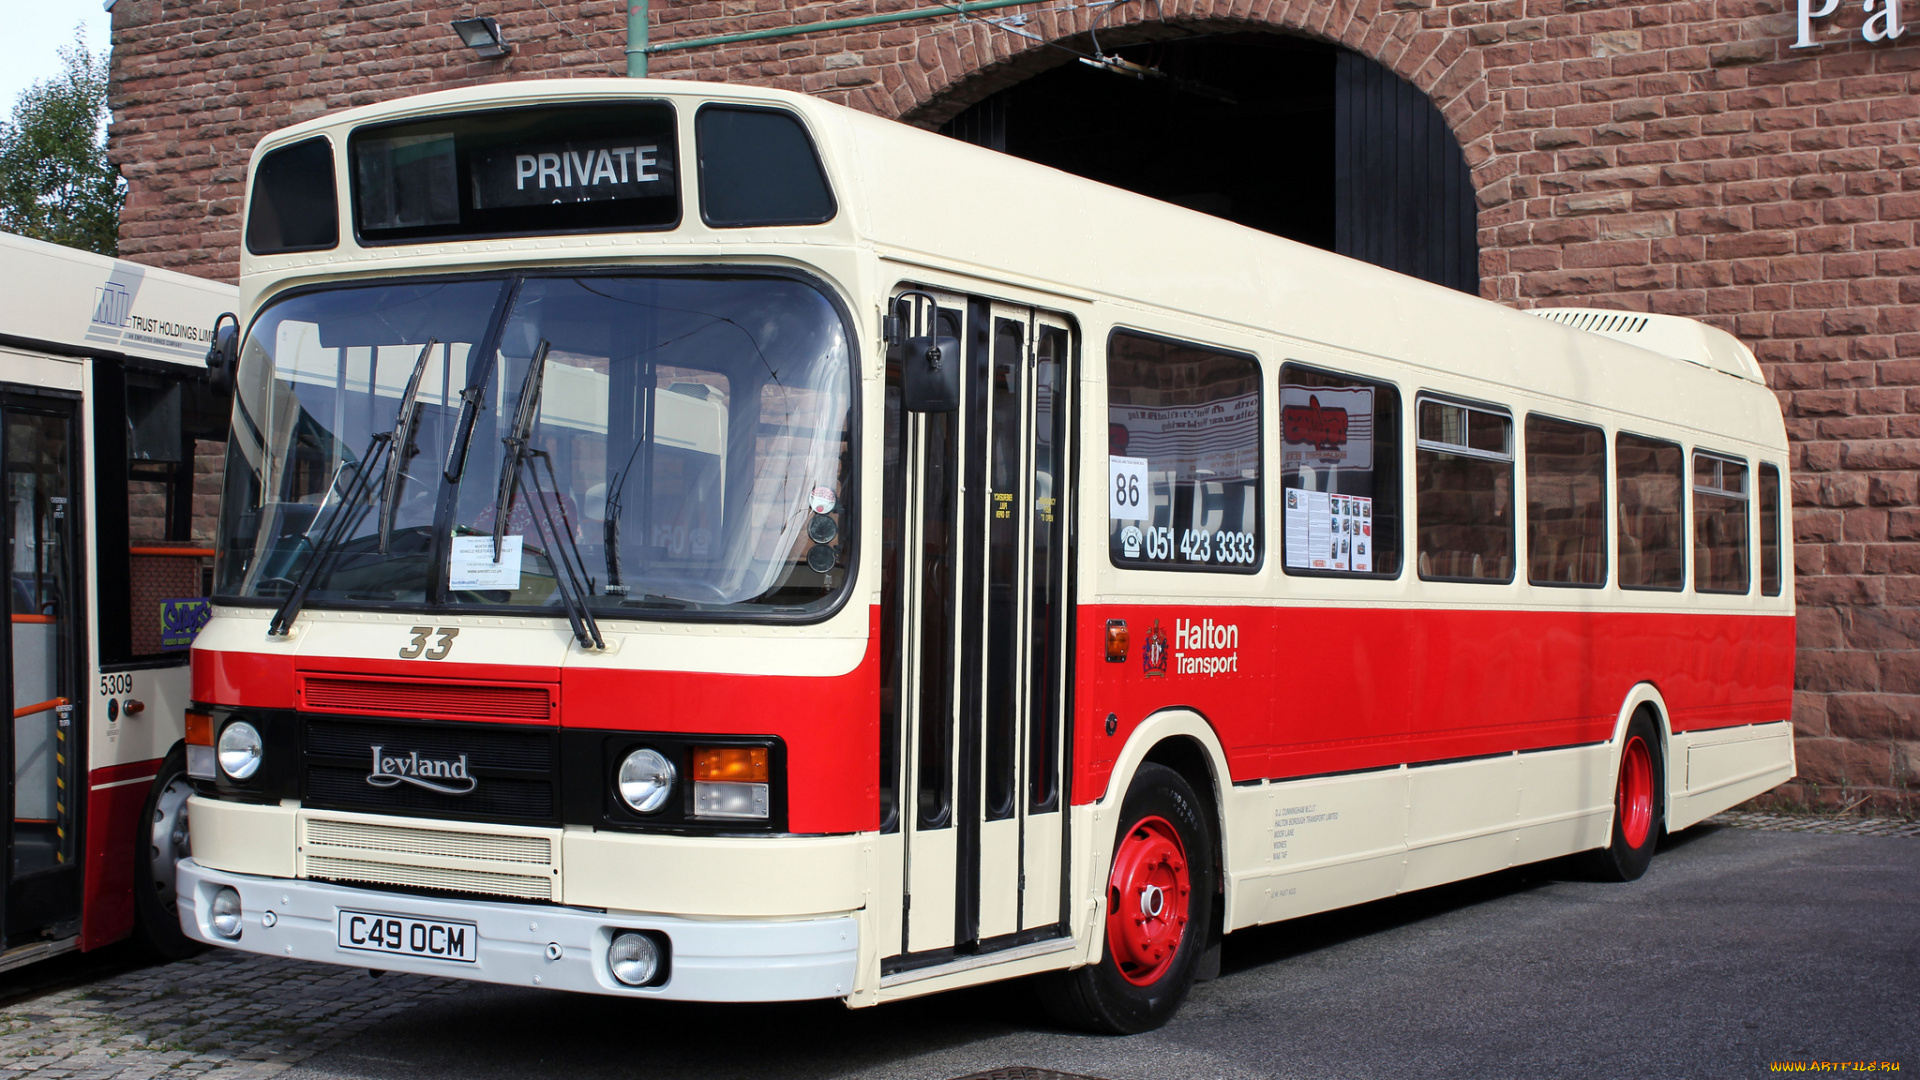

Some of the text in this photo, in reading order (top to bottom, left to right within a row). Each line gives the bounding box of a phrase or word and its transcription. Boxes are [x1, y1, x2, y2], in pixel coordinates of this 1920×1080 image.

[515, 145, 659, 190] PRIVATE
[132, 315, 158, 333] TRUST
[159, 321, 197, 341] HOLDINGS
[1116, 473, 1139, 507] 86
[1147, 525, 1175, 560] 051
[1180, 528, 1211, 562] 423
[1216, 531, 1255, 564] 3333
[399, 626, 460, 660] 33
[1175, 618, 1239, 650] Halton
[1175, 652, 1238, 677] Transport
[100, 674, 132, 696] 5309
[366, 745, 478, 794] Leyland
[1275, 812, 1338, 827] HALTON BOROUGH TRANSPORT LIMITED
[350, 916, 465, 957] C49 OCM
